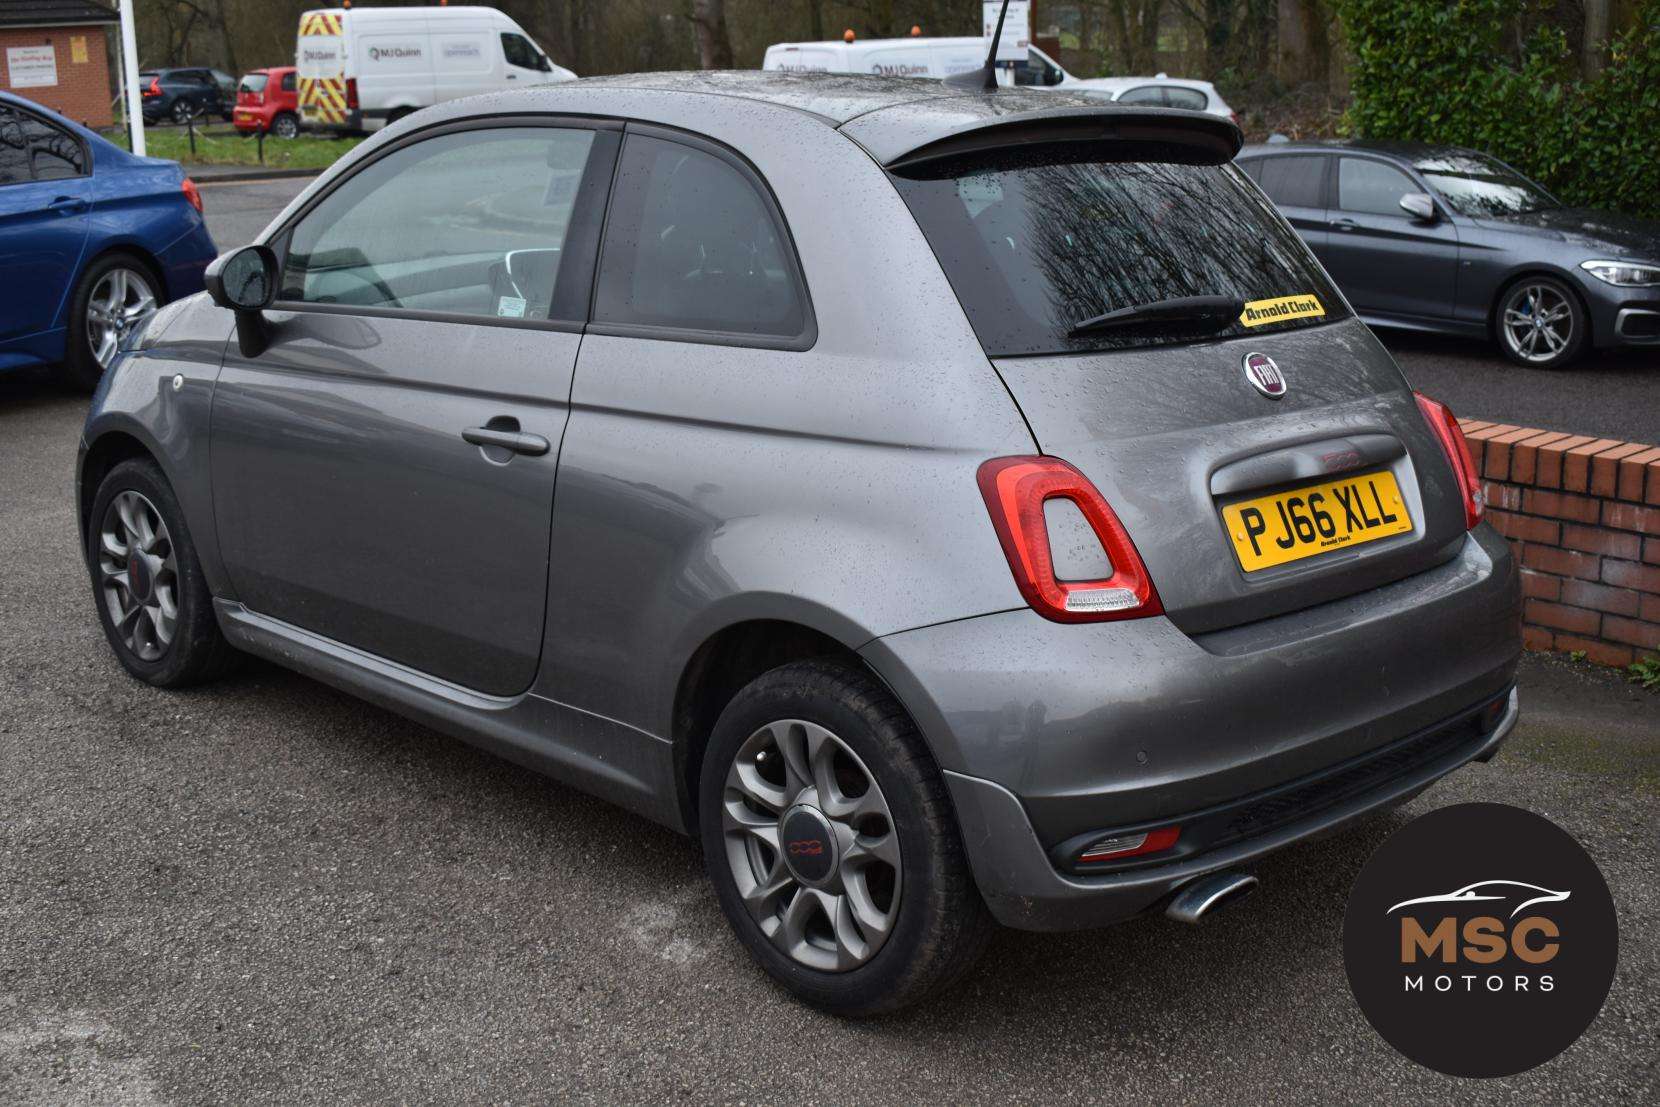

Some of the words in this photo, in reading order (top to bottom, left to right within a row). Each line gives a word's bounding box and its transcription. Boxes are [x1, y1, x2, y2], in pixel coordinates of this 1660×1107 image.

[1245, 303, 1289, 321] Arnold
[1288, 300, 1320, 313] Clark
[1253, 364, 1280, 386] FIAT
[1240, 492, 1336, 556] PJ66
[1332, 481, 1398, 533] XLL
[1320, 535, 1338, 547] Arnold
[1338, 534, 1351, 543] Clark
